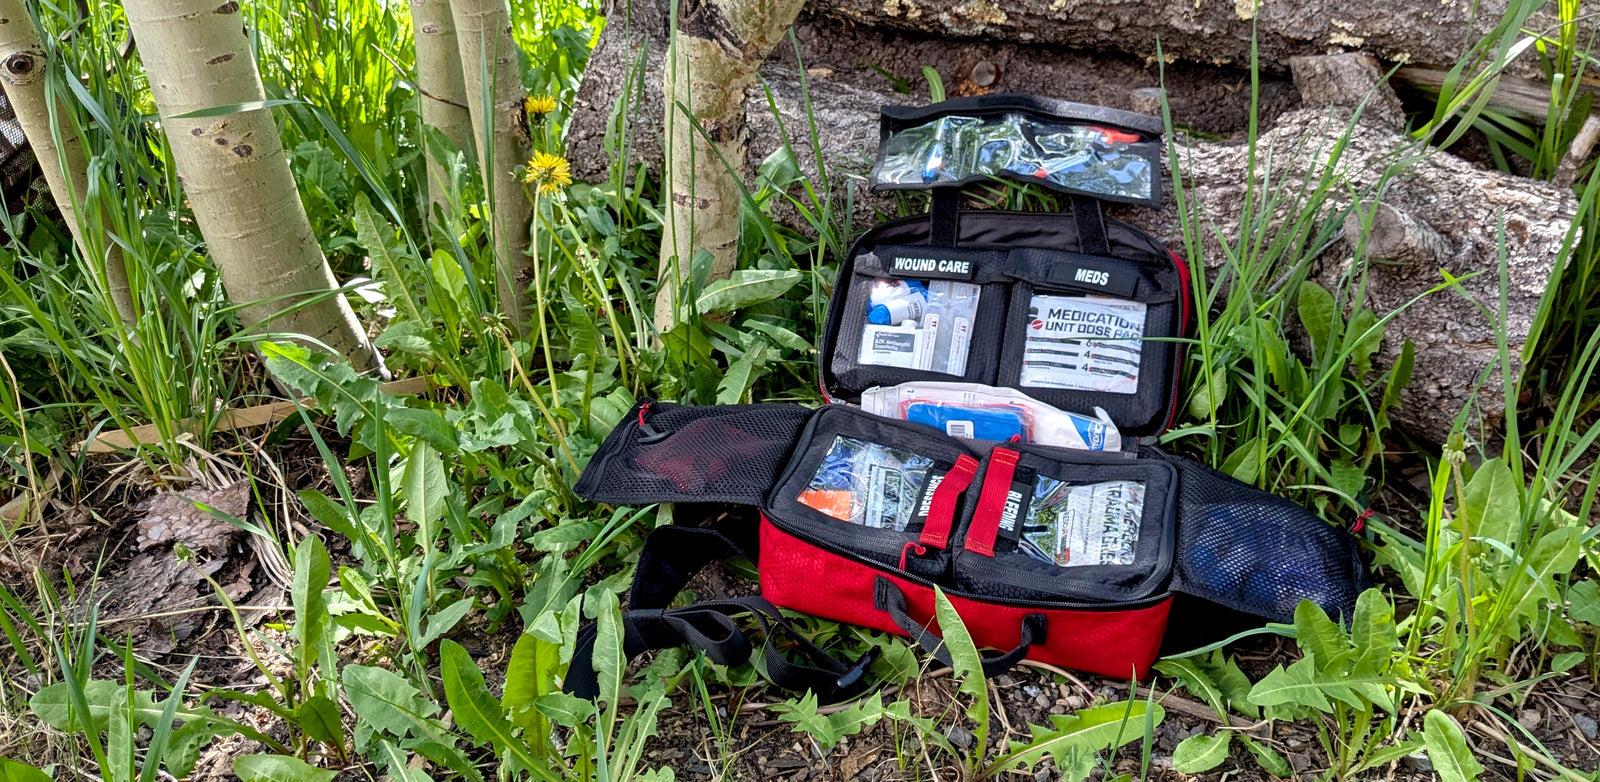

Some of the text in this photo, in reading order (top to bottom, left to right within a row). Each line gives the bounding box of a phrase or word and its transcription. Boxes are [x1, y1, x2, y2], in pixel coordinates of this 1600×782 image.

[894, 257, 970, 274] WOUND CARE
[1074, 268, 1110, 286] MEDS
[1047, 308, 1141, 332] MEDICATION
[1045, 321, 1143, 344] UNIT DOSE PAC
[1085, 339, 1092, 348] 6
[1083, 350, 1090, 359] 4
[1081, 363, 1088, 372] 4
[998, 490, 1023, 532] BLEEDING
[1102, 484, 1123, 534] TRAUMA
